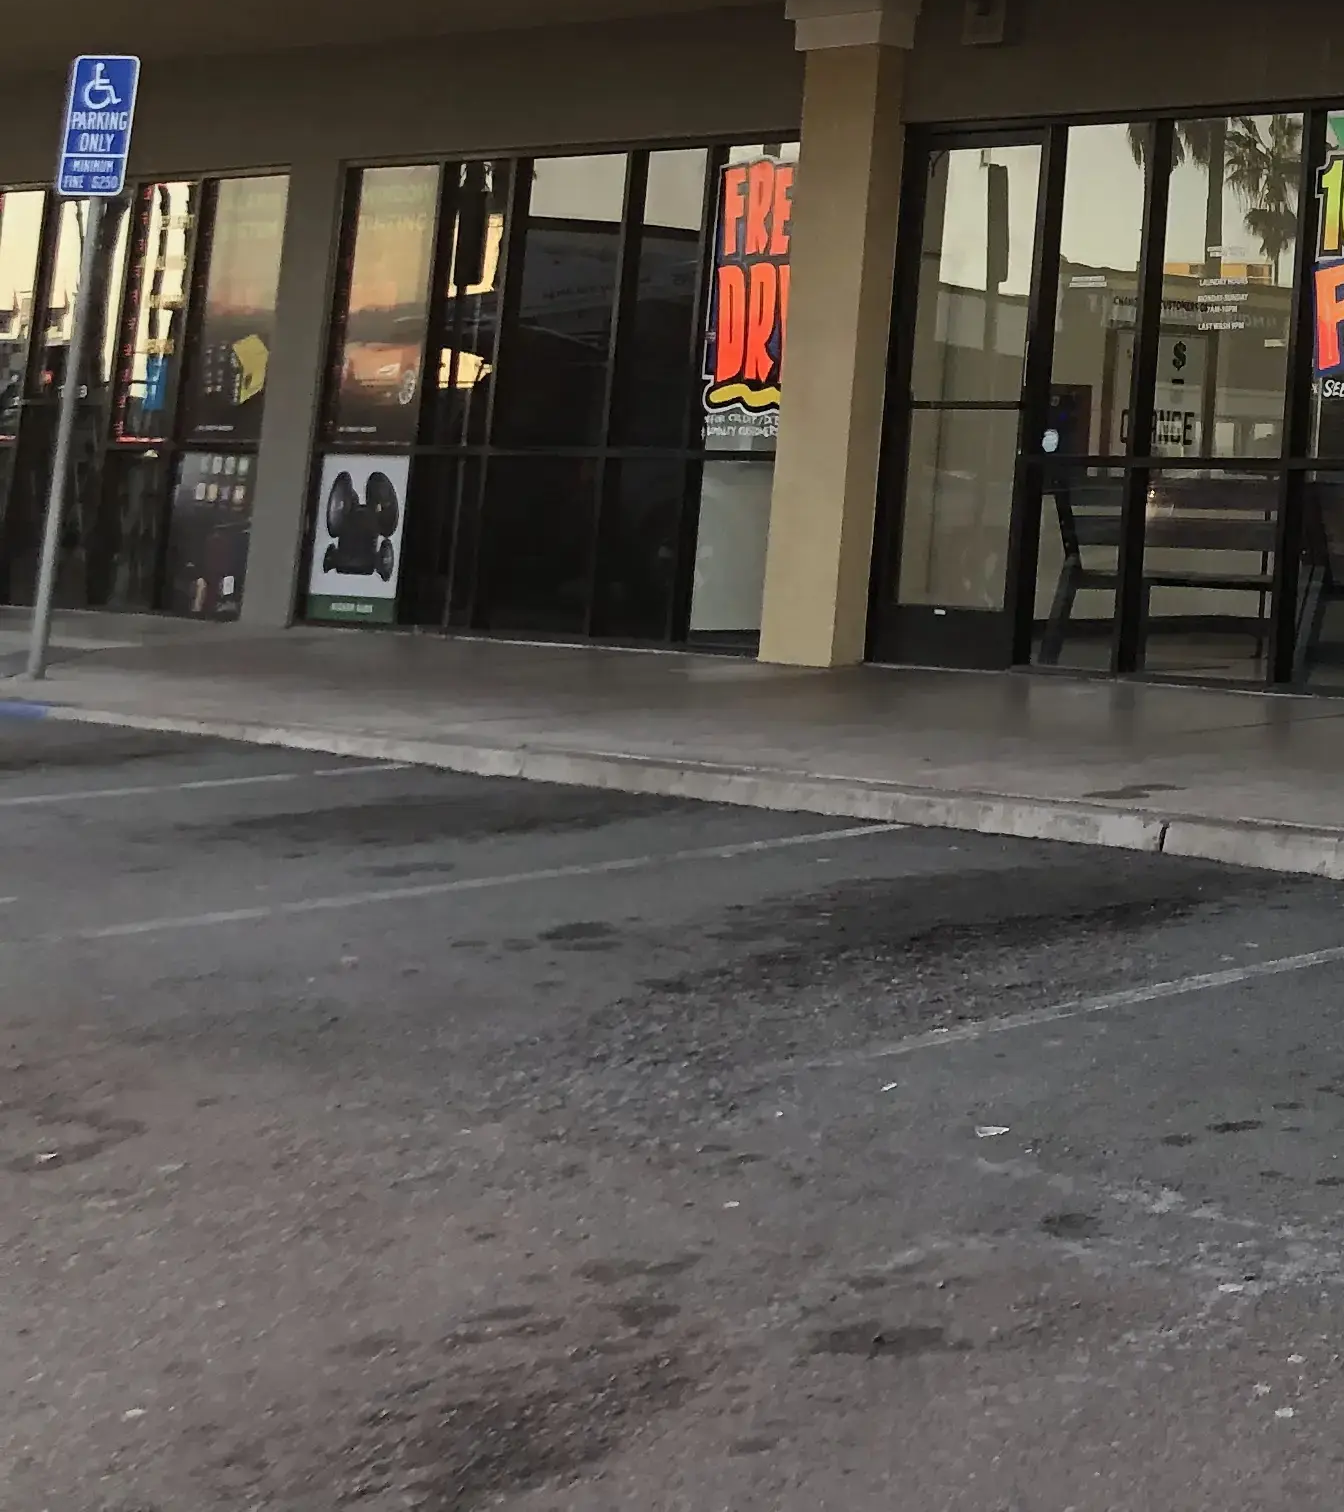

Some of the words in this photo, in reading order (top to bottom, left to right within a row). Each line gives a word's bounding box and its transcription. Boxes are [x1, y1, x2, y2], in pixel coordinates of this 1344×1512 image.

[72, 111, 128, 131] PARKING
[79, 132, 114, 152] ONLY
[72, 159, 114, 172] MINIMUM
[62, 175, 84, 188] FINE
[91, 175, 119, 189] $250
[724, 161, 794, 256] FRE
[1172, 340, 1187, 371] $
